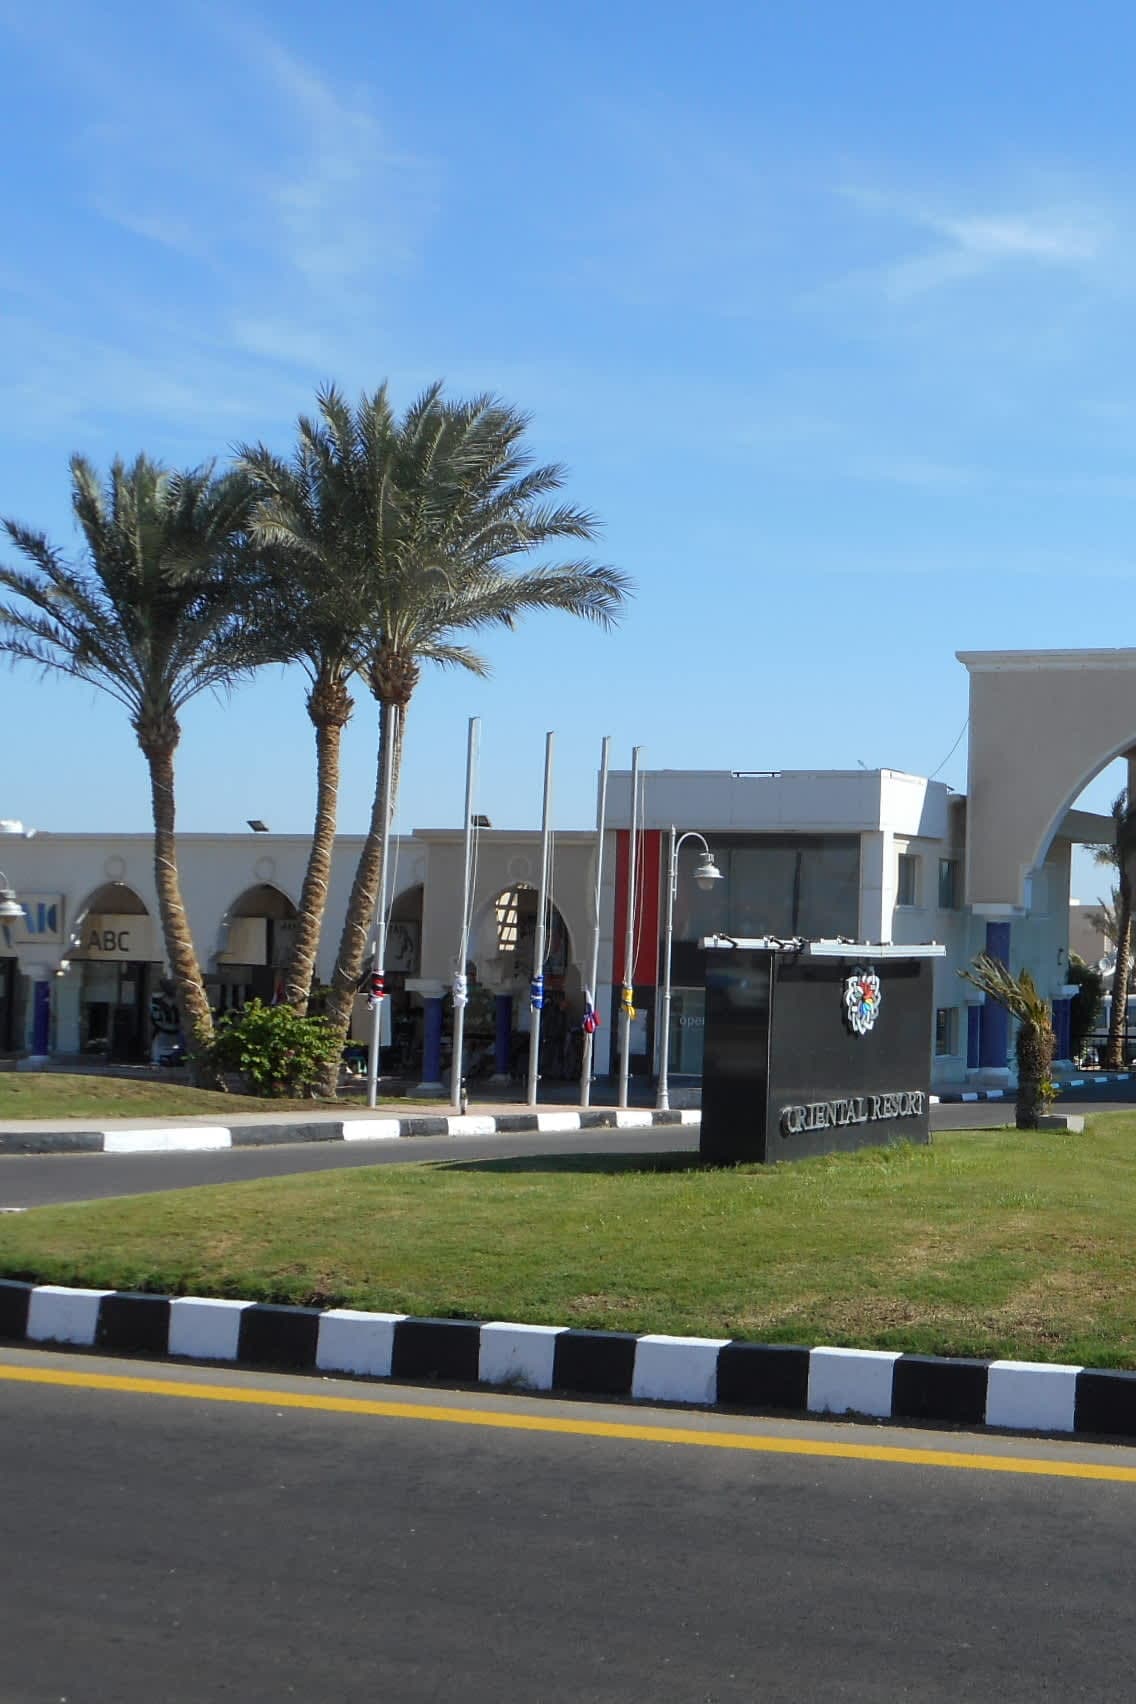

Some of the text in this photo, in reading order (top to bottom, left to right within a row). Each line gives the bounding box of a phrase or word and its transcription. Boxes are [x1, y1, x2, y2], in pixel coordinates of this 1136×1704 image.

[88, 930, 129, 951] ABC
[780, 1090, 926, 1135] ORIENTAL RESORT
